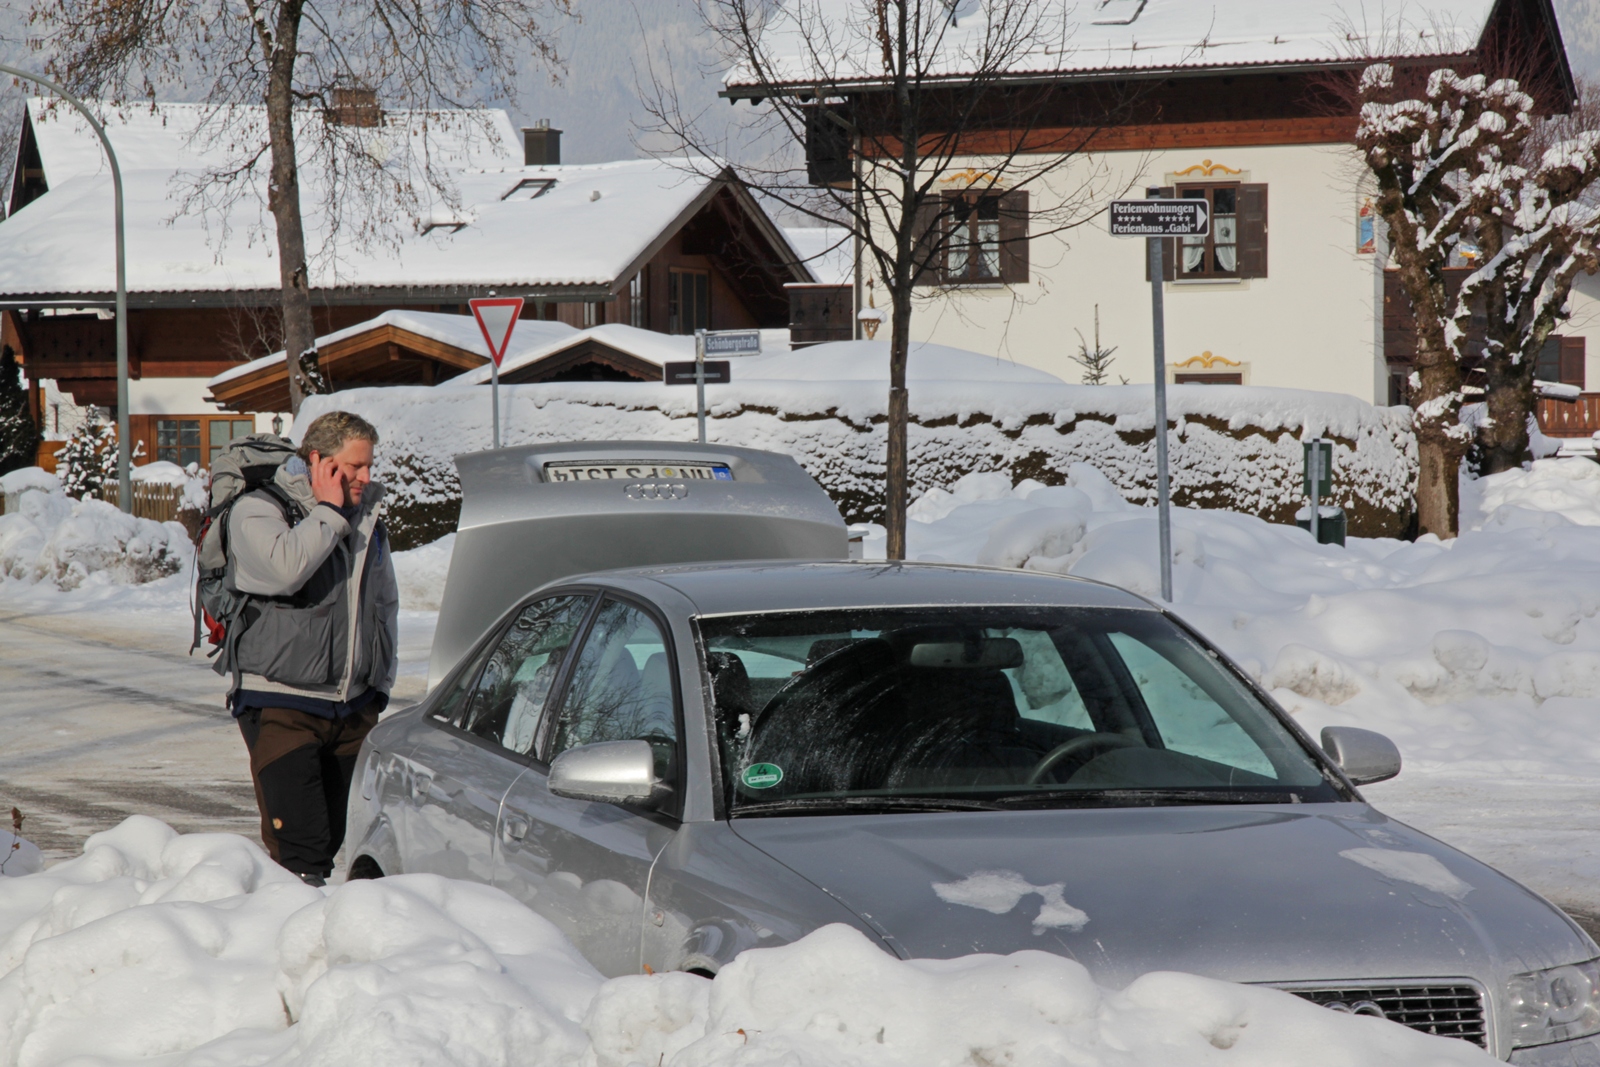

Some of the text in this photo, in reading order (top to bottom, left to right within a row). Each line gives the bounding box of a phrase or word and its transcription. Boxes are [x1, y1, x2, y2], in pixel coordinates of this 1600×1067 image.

[1113, 203, 1194, 215] Ferienwohnungen
[1113, 223, 1163, 233] Ferienhaus
[707, 336, 758, 351] Schönbergstraße
